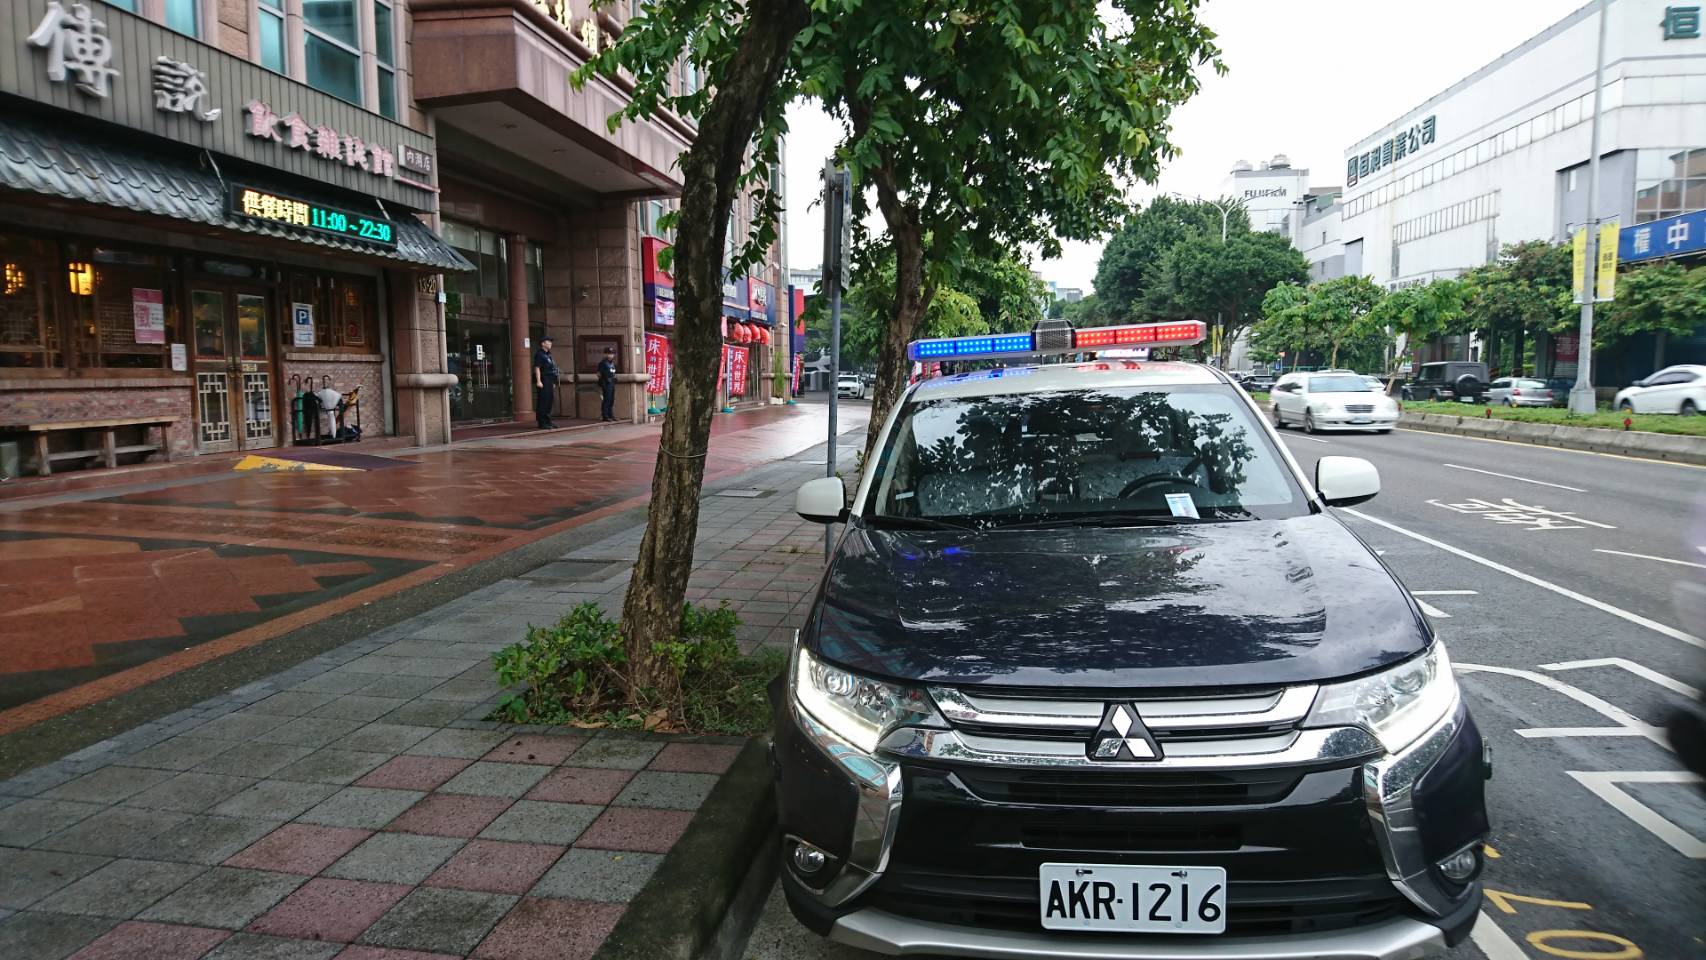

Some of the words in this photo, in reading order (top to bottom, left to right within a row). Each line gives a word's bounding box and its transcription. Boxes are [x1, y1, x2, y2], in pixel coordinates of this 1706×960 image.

[1244, 187, 1287, 198] FUJIFILM
[312, 208, 347, 232] 11:00
[359, 219, 391, 242] 22:30
[646, 338, 661, 391] 床的世界
[733, 350, 747, 393] 床的世界
[1046, 880, 1222, 922] AKR-1216
